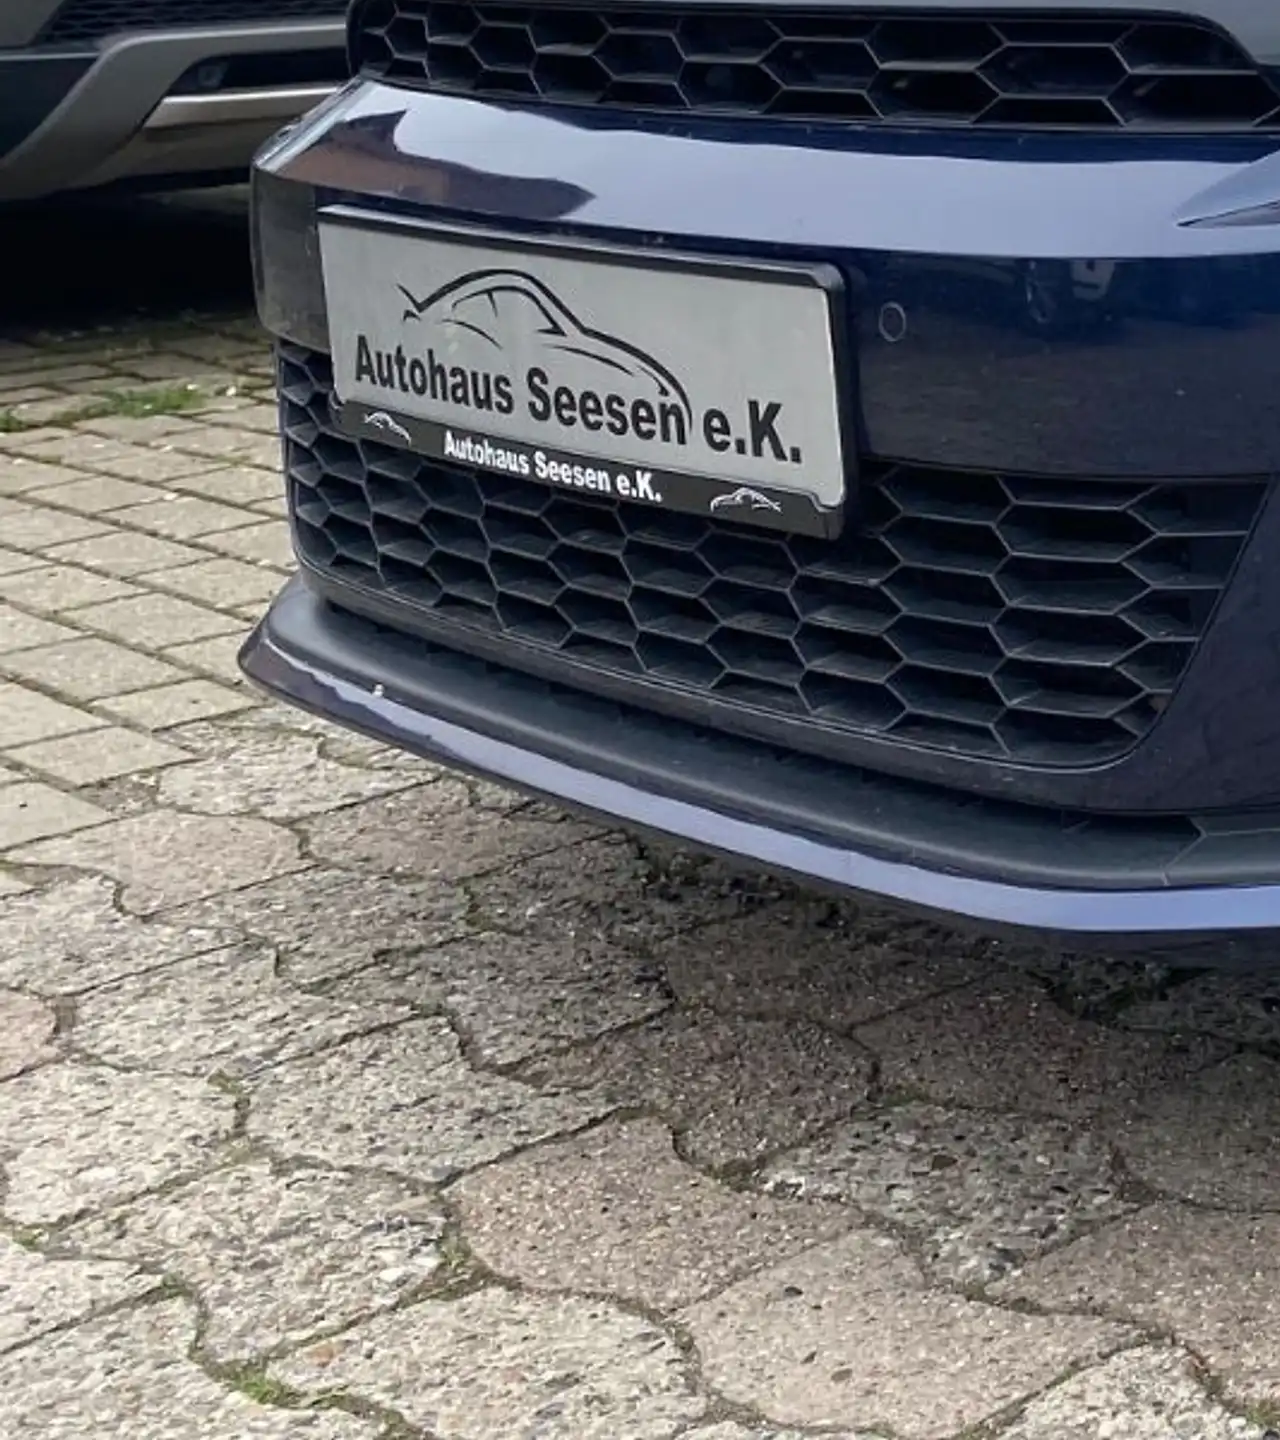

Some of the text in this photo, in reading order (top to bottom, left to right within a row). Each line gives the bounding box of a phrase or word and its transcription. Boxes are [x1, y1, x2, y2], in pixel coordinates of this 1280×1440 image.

[355, 334, 802, 465] Autohaus Seesen e.K.
[444, 429, 663, 503] Autohaus Seesen e.K.
